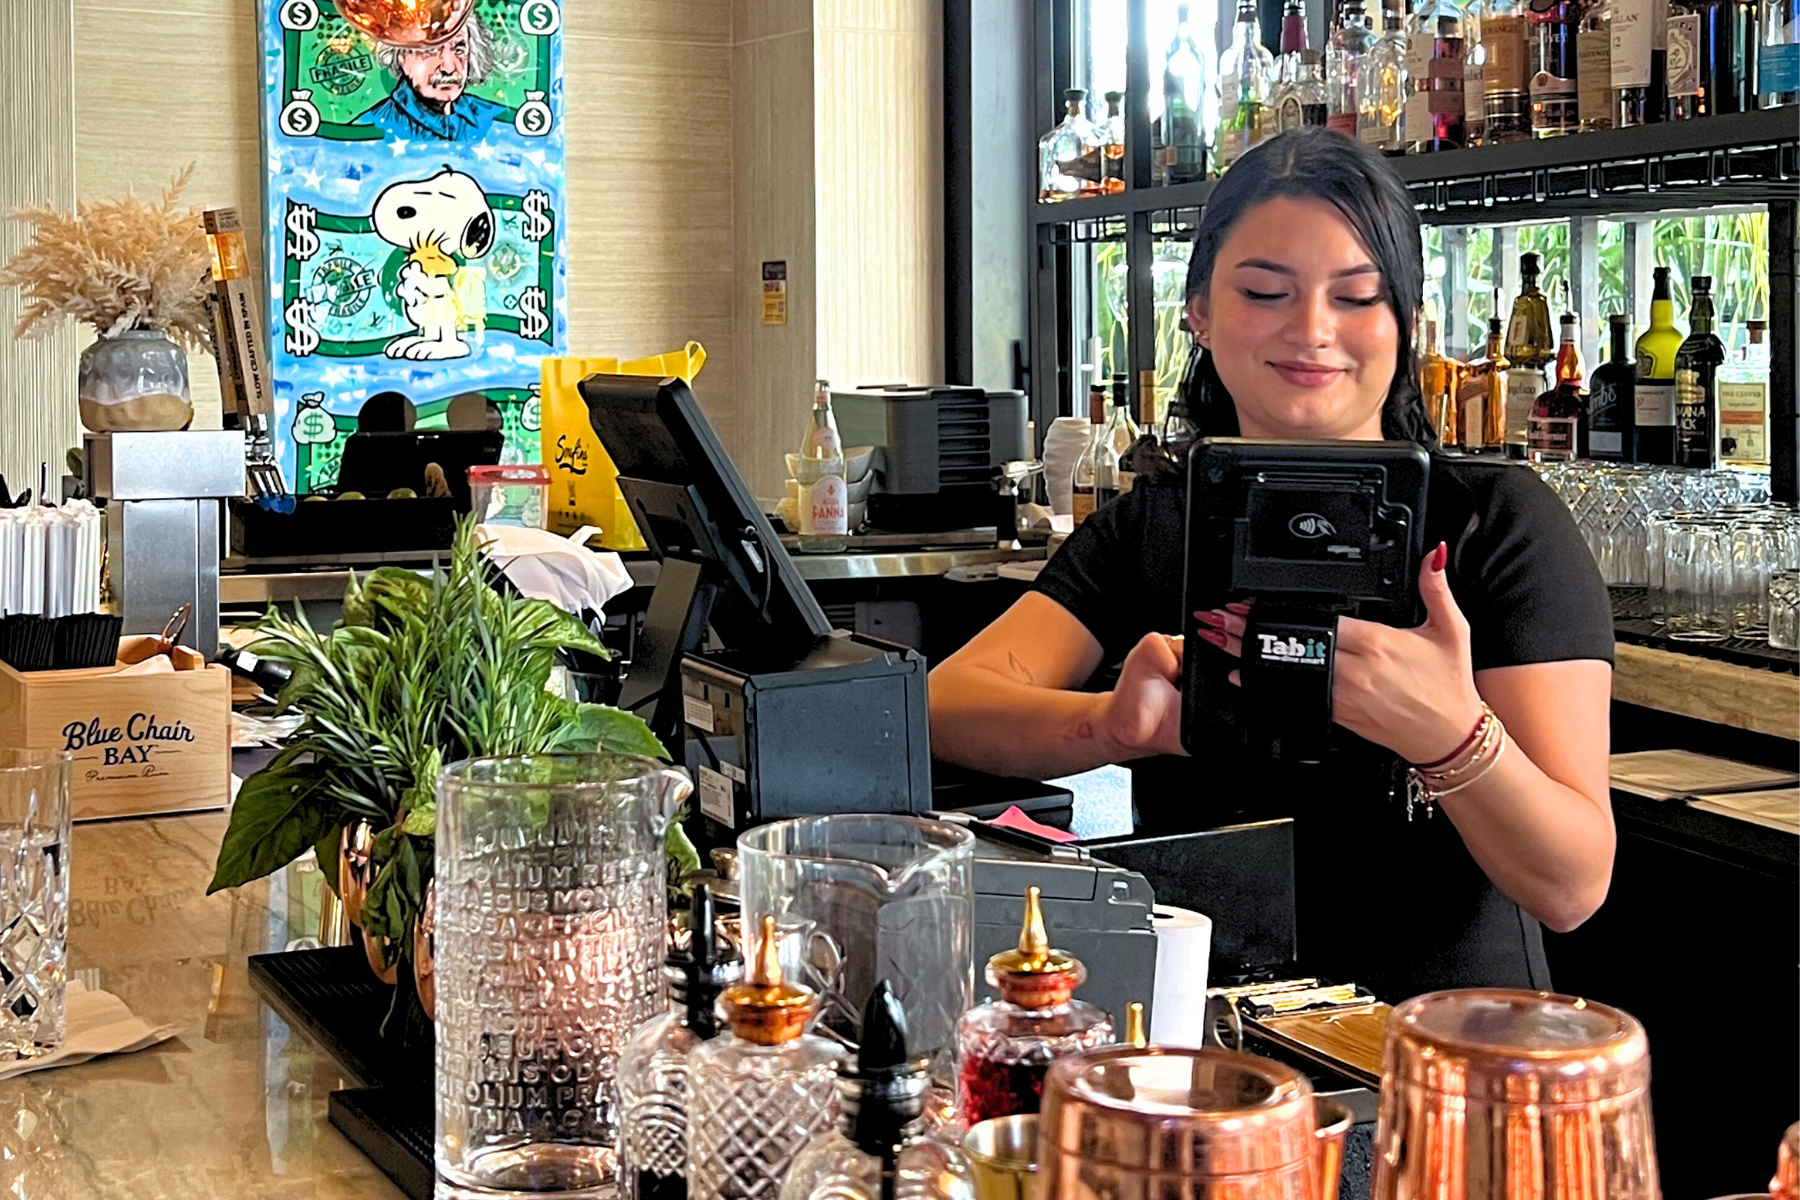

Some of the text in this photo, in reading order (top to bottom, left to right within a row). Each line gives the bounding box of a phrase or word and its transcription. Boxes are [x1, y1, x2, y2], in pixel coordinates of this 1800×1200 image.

[238, 292, 262, 399] SLOW CRAFTED IN SPAIN
[1257, 634, 1326, 658] Tabit
[62, 712, 195, 752] Blue Chair
[103, 744, 154, 766] BAY
